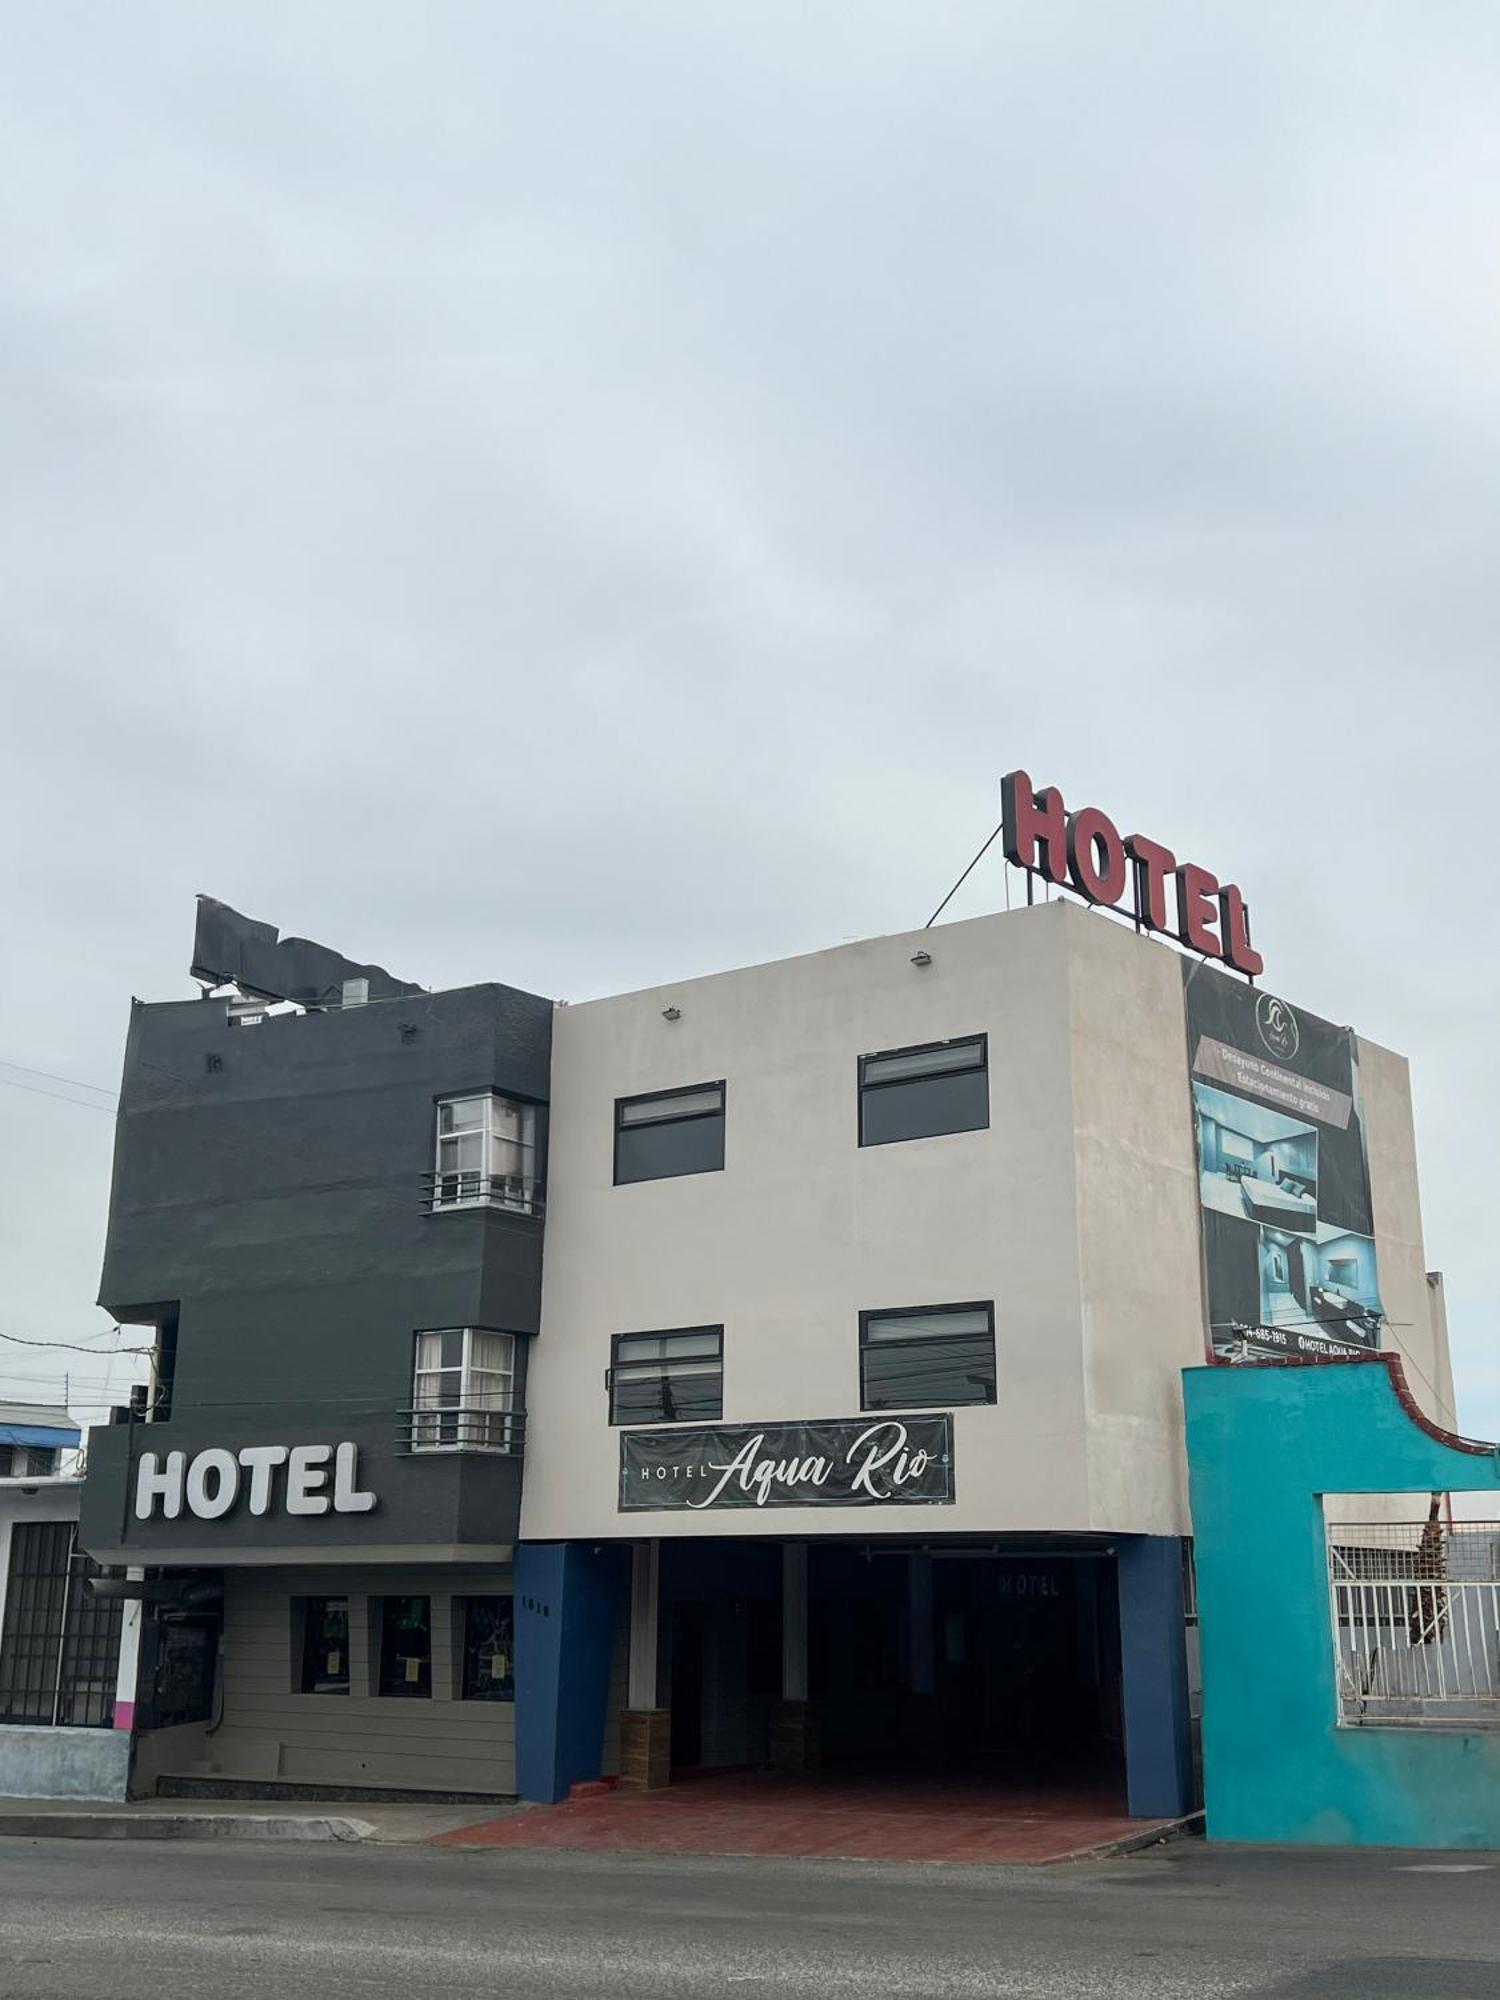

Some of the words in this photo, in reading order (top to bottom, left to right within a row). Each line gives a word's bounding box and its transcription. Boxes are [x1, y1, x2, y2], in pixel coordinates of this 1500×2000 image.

[1001, 769, 1264, 976] HOTEL
[1222, 1048, 1259, 1073] Desayuno
[1261, 1064, 1302, 1090] Continental
[1304, 1338, 1329, 1354] HOTEL
[135, 1442, 377, 1520] HOTEL
[641, 1465, 708, 1480] HOTEL
[686, 1433, 834, 1509] Aqua
[846, 1421, 938, 1499] Rio
